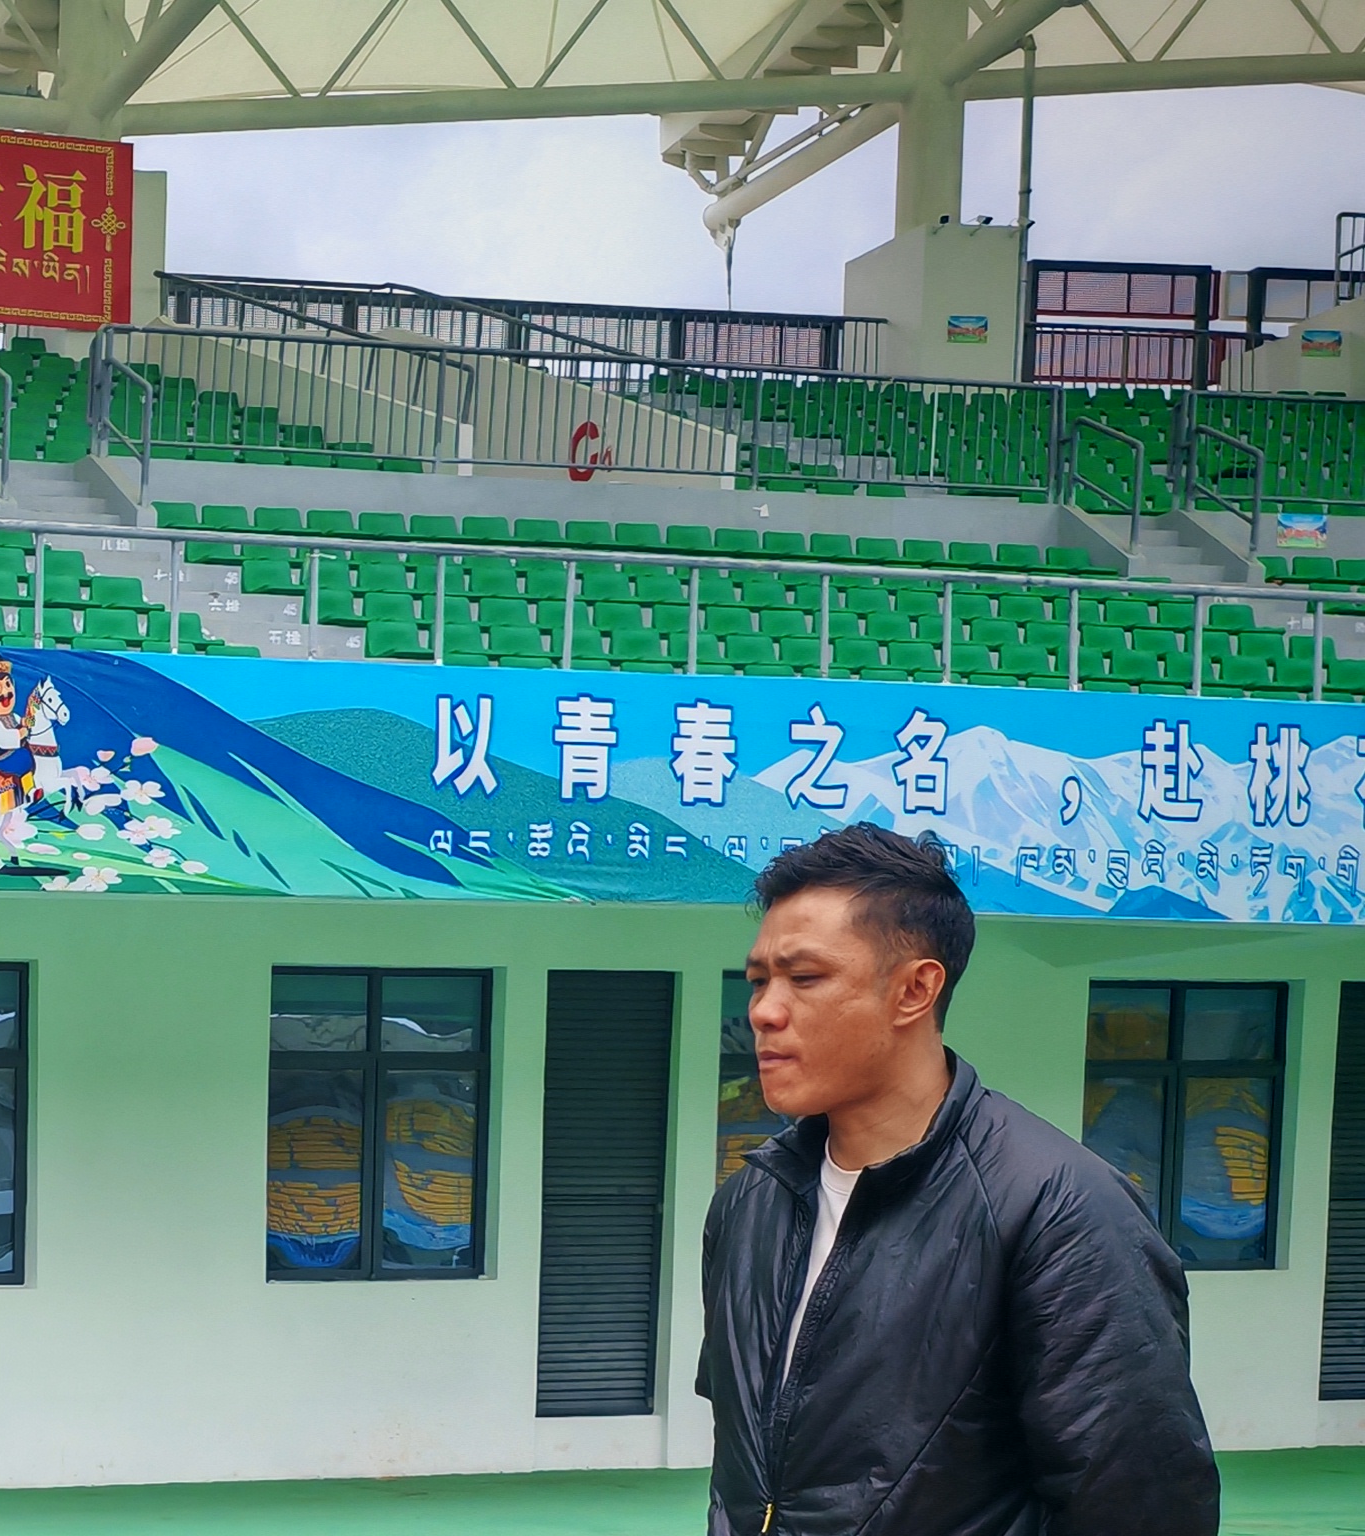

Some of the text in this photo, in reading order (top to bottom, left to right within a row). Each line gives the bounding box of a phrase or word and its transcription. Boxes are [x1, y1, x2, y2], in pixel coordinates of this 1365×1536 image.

[431, 692, 1365, 828] 以青春之名，赴桃
